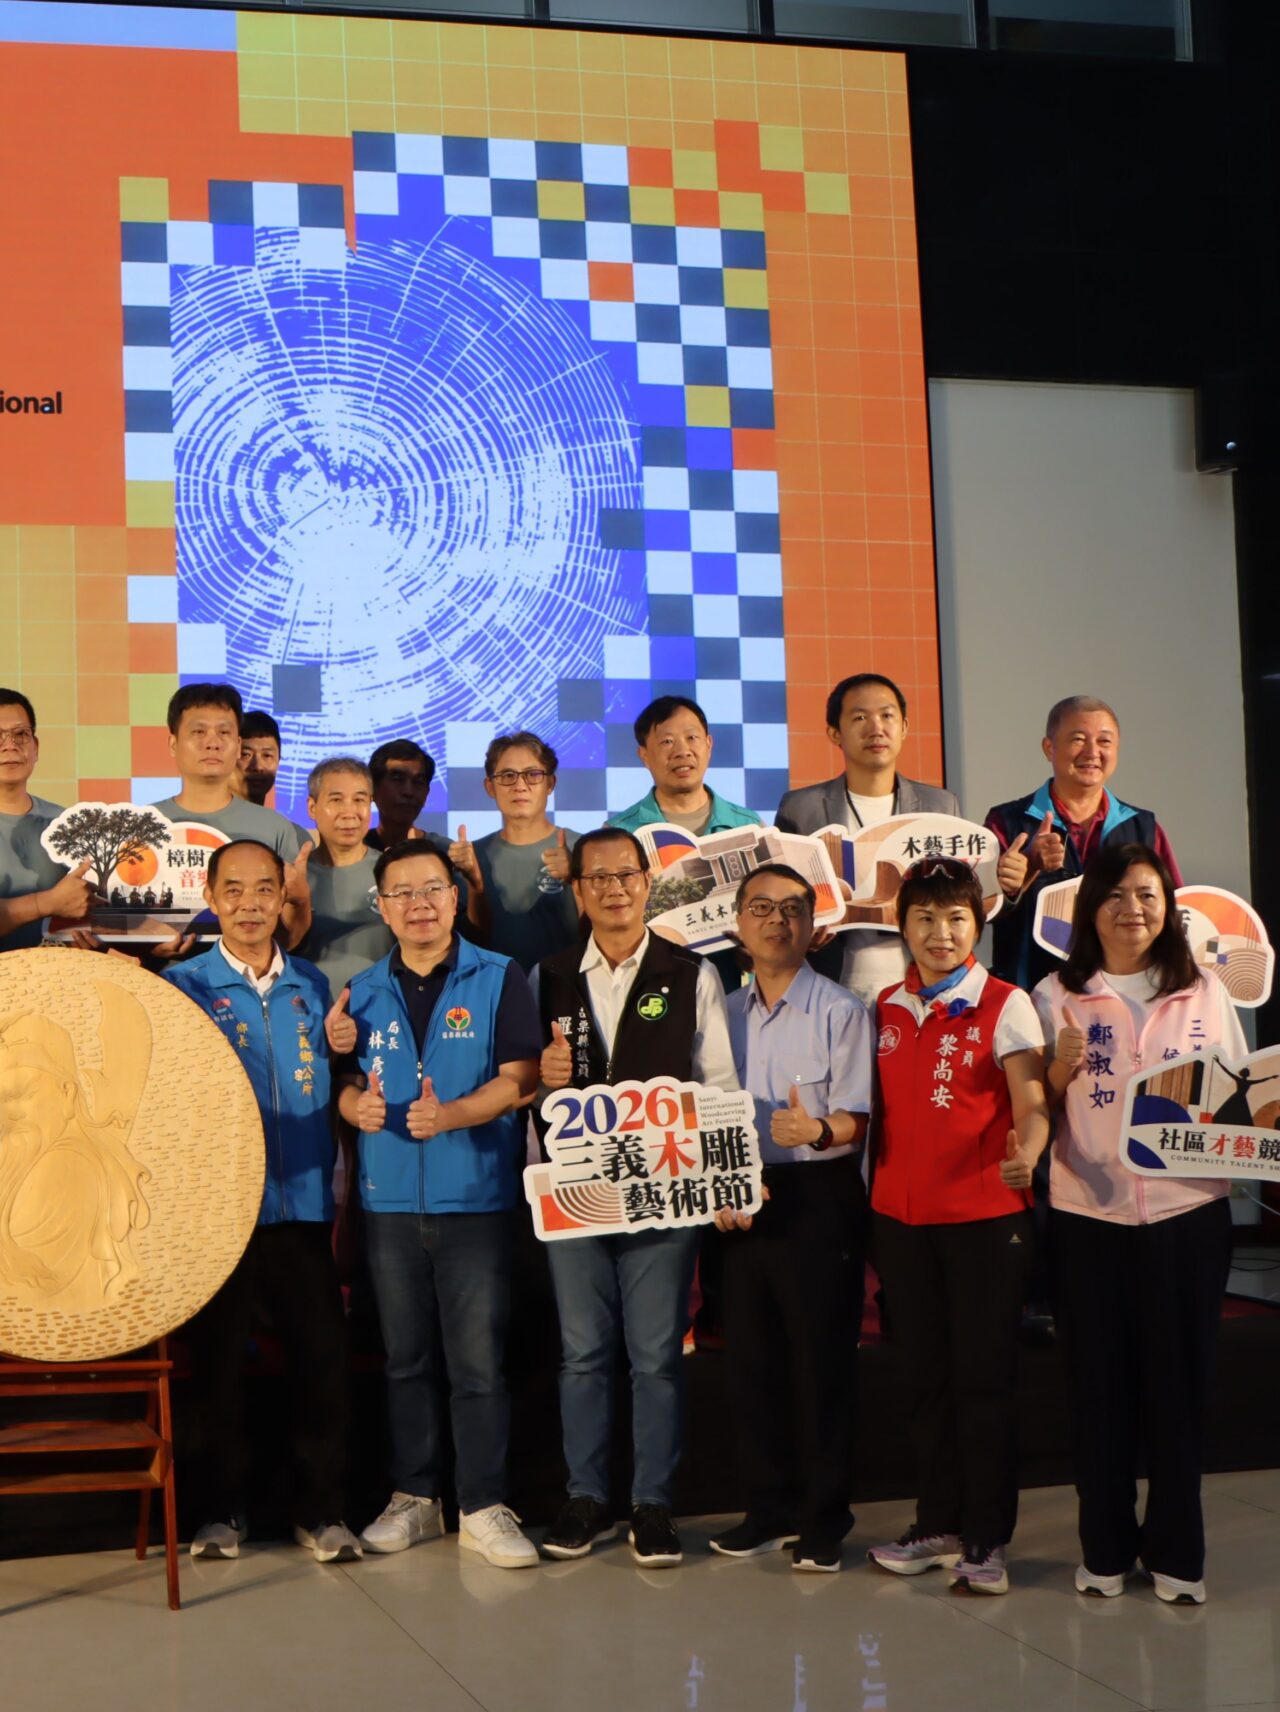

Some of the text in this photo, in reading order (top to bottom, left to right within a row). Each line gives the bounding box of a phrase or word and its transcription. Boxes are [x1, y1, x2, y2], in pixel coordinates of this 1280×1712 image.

[166, 848, 214, 868] 樟樹
[901, 833, 987, 859] 木藝手作
[930, 1033, 959, 1110] 黎尚安
[1087, 1022, 1116, 1109] 鄭淑如
[550, 1085, 679, 1140] 2026
[557, 1126, 753, 1185] 三義木雕
[1170, 1154, 1226, 1165] COMMUNITY
[1230, 1160, 1265, 1169] TALENT
[622, 1173, 753, 1224] 藝術節
